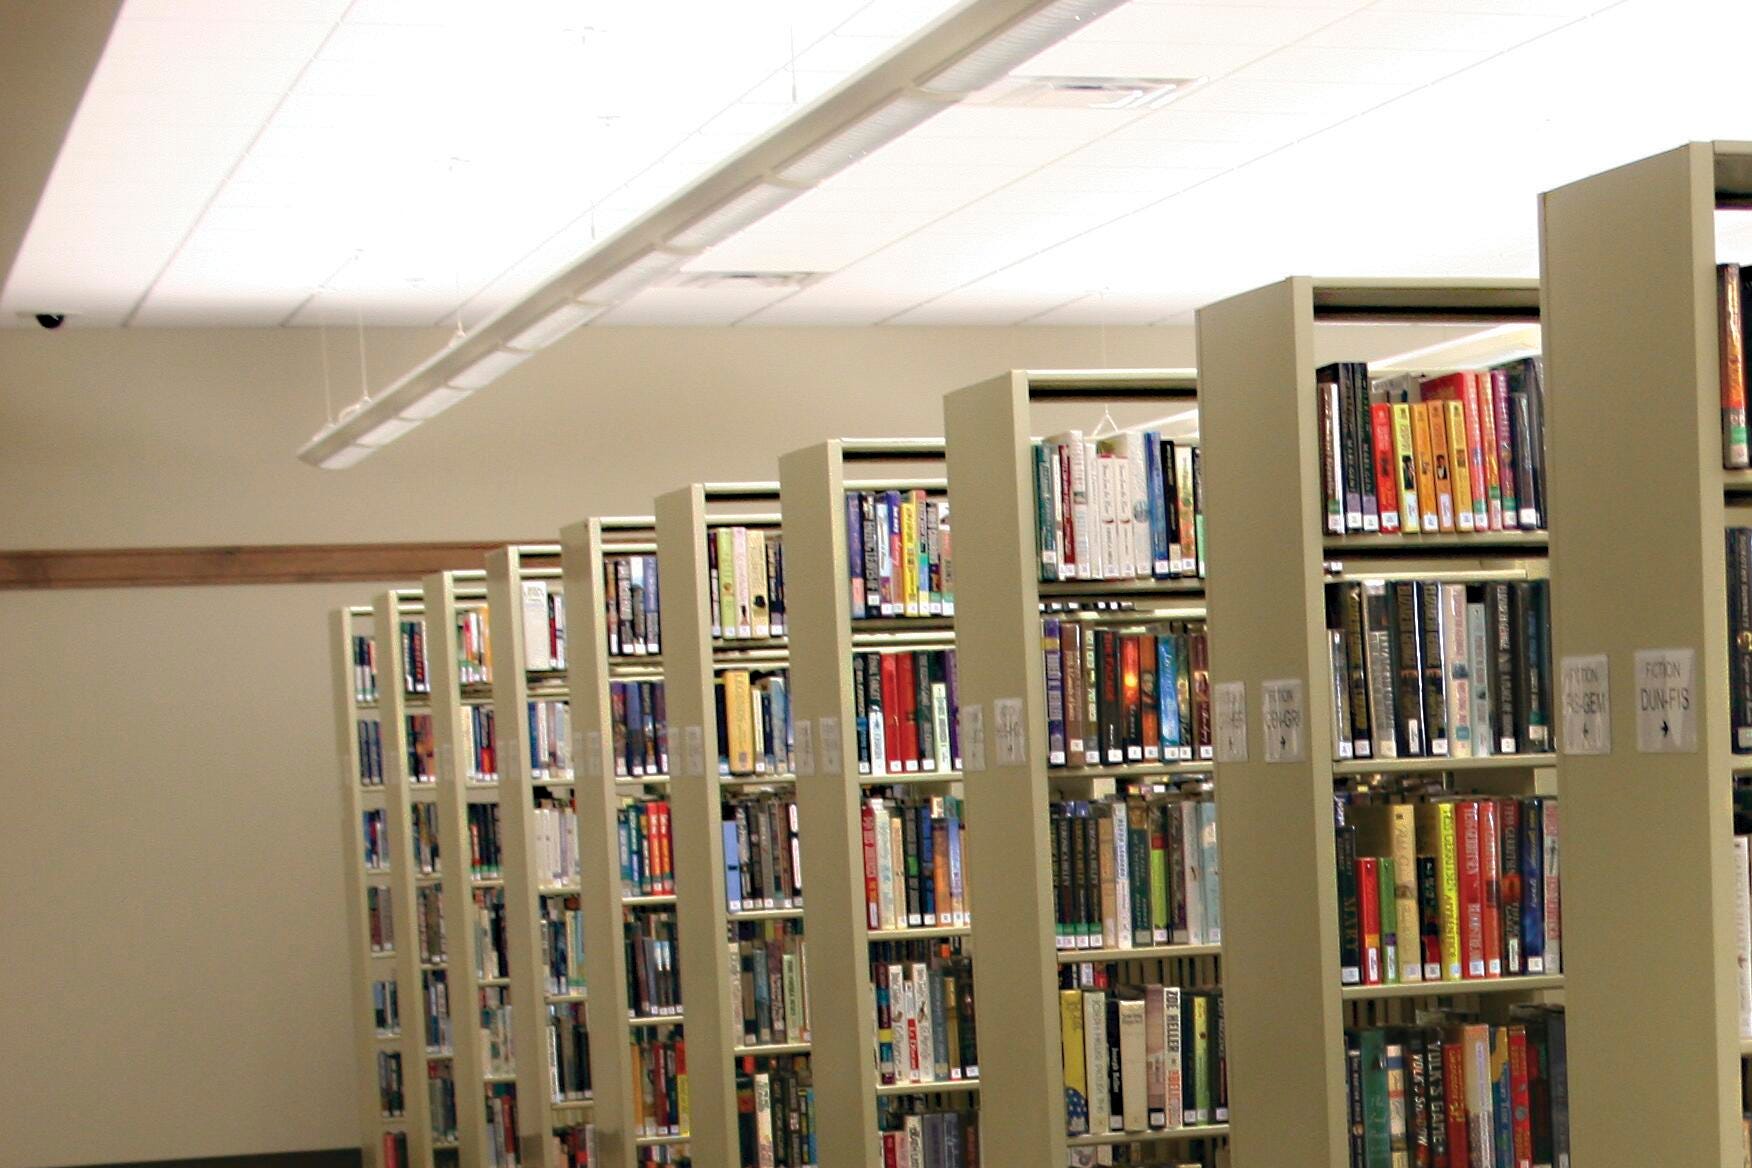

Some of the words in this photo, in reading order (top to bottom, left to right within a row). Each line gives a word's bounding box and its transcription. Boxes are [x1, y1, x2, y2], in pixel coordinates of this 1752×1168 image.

[1166, 991, 1180, 1010] ZOE
[1166, 1015, 1180, 1053] HELLER
[1427, 1042, 1442, 1097] VOLK'S
[1429, 1101, 1445, 1144] GAME
